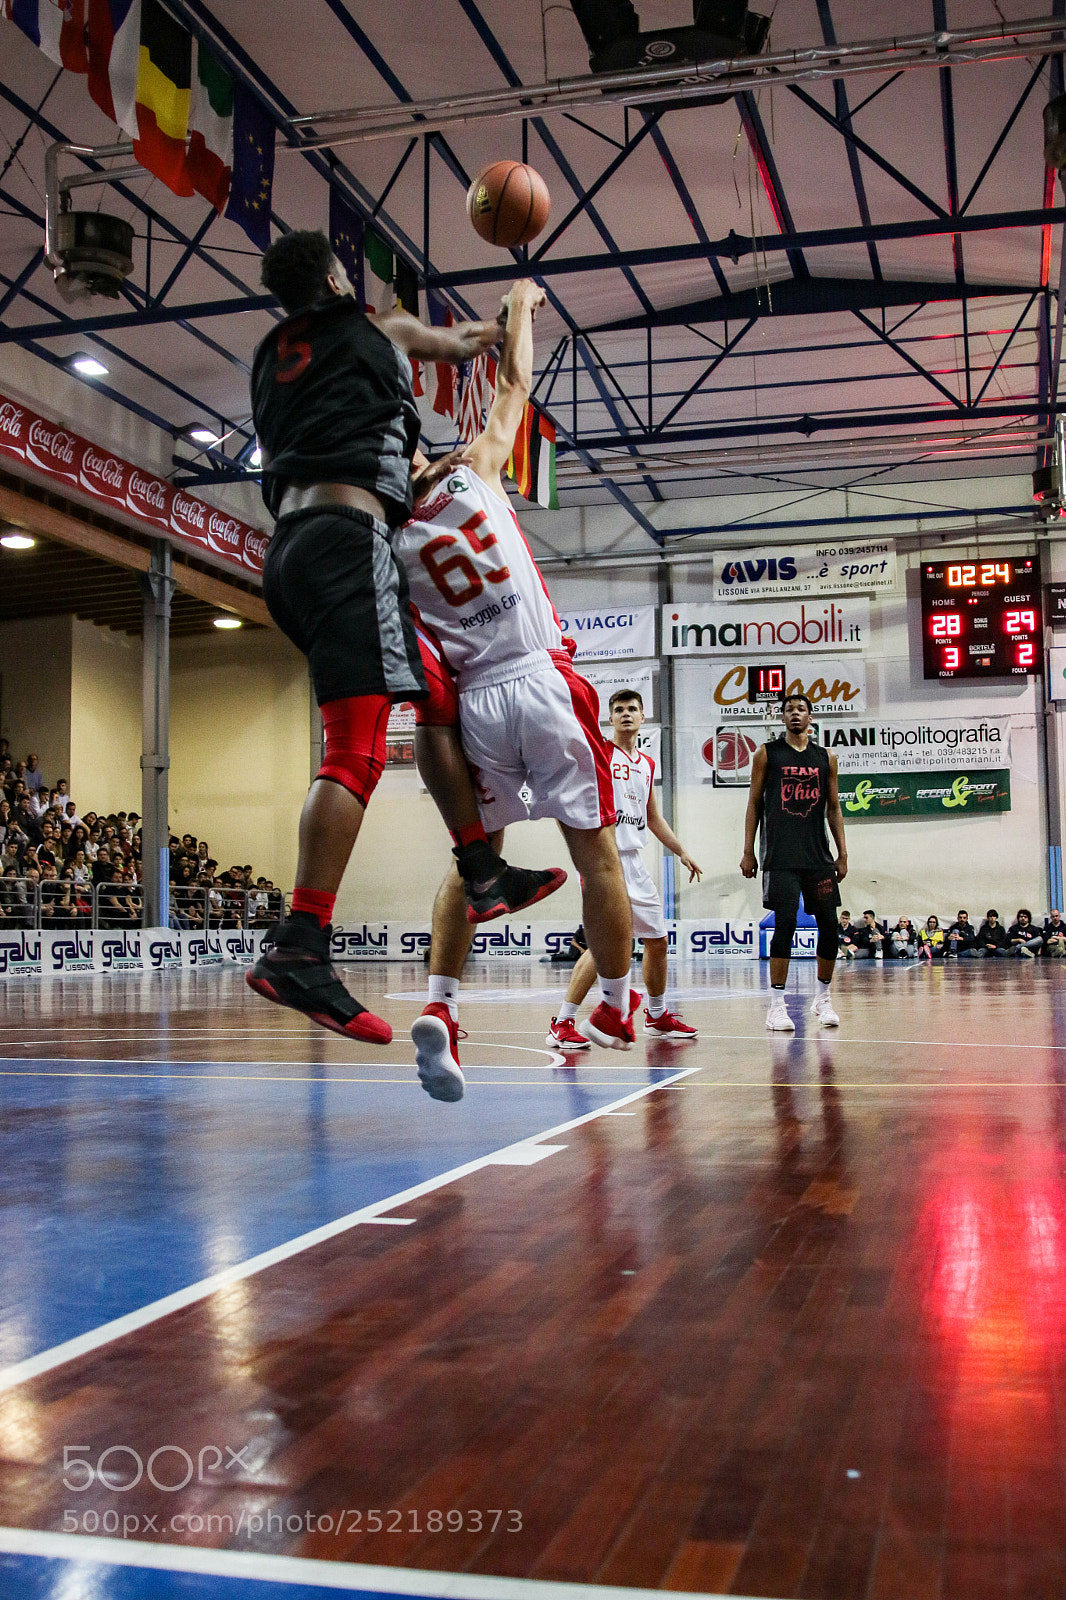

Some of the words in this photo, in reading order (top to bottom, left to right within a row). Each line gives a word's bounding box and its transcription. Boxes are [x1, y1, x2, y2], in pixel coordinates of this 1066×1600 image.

[276, 314, 313, 382] 5
[419, 509, 511, 608] 65
[816, 549, 837, 557] INFO
[720, 557, 798, 585] AVIS
[840, 560, 888, 580] sport
[948, 566, 976, 586] 02
[982, 564, 1010, 584] 24
[718, 587, 749, 596] LISSONE
[932, 598, 956, 606] HOME
[1003, 594, 1031, 603] GUEST
[459, 604, 501, 631] Reggio
[575, 614, 634, 631] VIAGGI
[671, 603, 862, 648] imamobili.it
[932, 614, 961, 636] 28
[1006, 610, 1035, 633] 29
[944, 647, 960, 668] 3
[1018, 643, 1033, 665] 2
[760, 669, 783, 692] 10
[824, 728, 876, 748] IANI
[879, 723, 1002, 750] tipolitografia
[937, 746, 988, 757] 039/483215
[612, 763, 630, 781] 23
[781, 766, 820, 776] TEAM
[781, 782, 820, 802] Ohio
[332, 924, 388, 954] galvi
[472, 924, 531, 954] galvi
[690, 922, 753, 953] galvi
[0, 931, 41, 973] galvi
[52, 931, 94, 970] galvi
[102, 931, 142, 967] galvi
[9, 966, 42, 975] LISSONE
[65, 963, 95, 972] LISSONE
